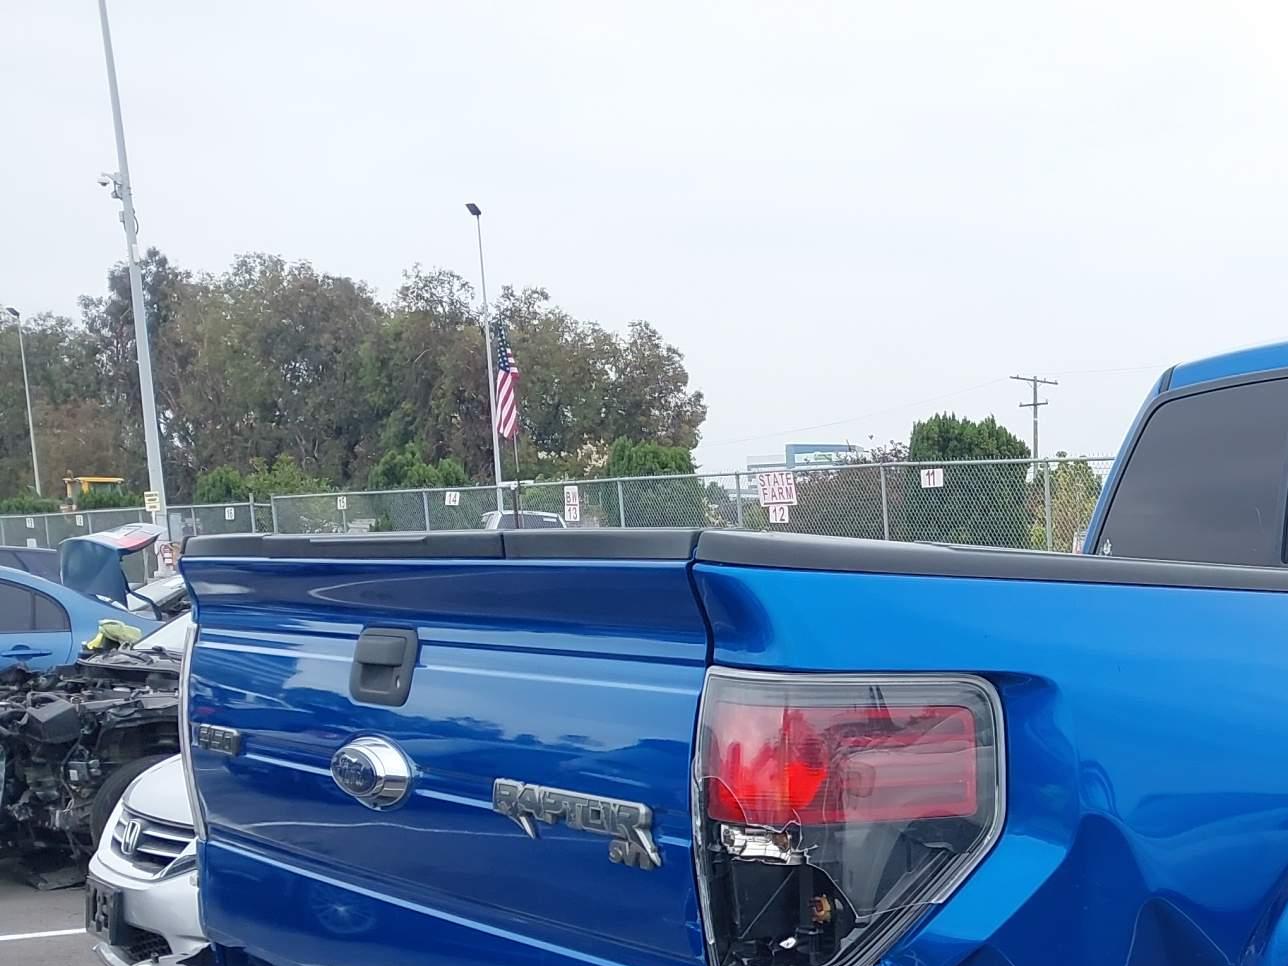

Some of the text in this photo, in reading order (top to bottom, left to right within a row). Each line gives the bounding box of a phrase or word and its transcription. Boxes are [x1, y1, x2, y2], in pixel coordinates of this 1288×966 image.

[758, 472, 793, 487] STATE
[926, 471, 937, 486] 11
[448, 494, 458, 504] 14
[762, 487, 794, 501] FARM
[567, 508, 578, 520] 13
[771, 507, 786, 522] 12
[492, 778, 661, 867] RAPTOR
